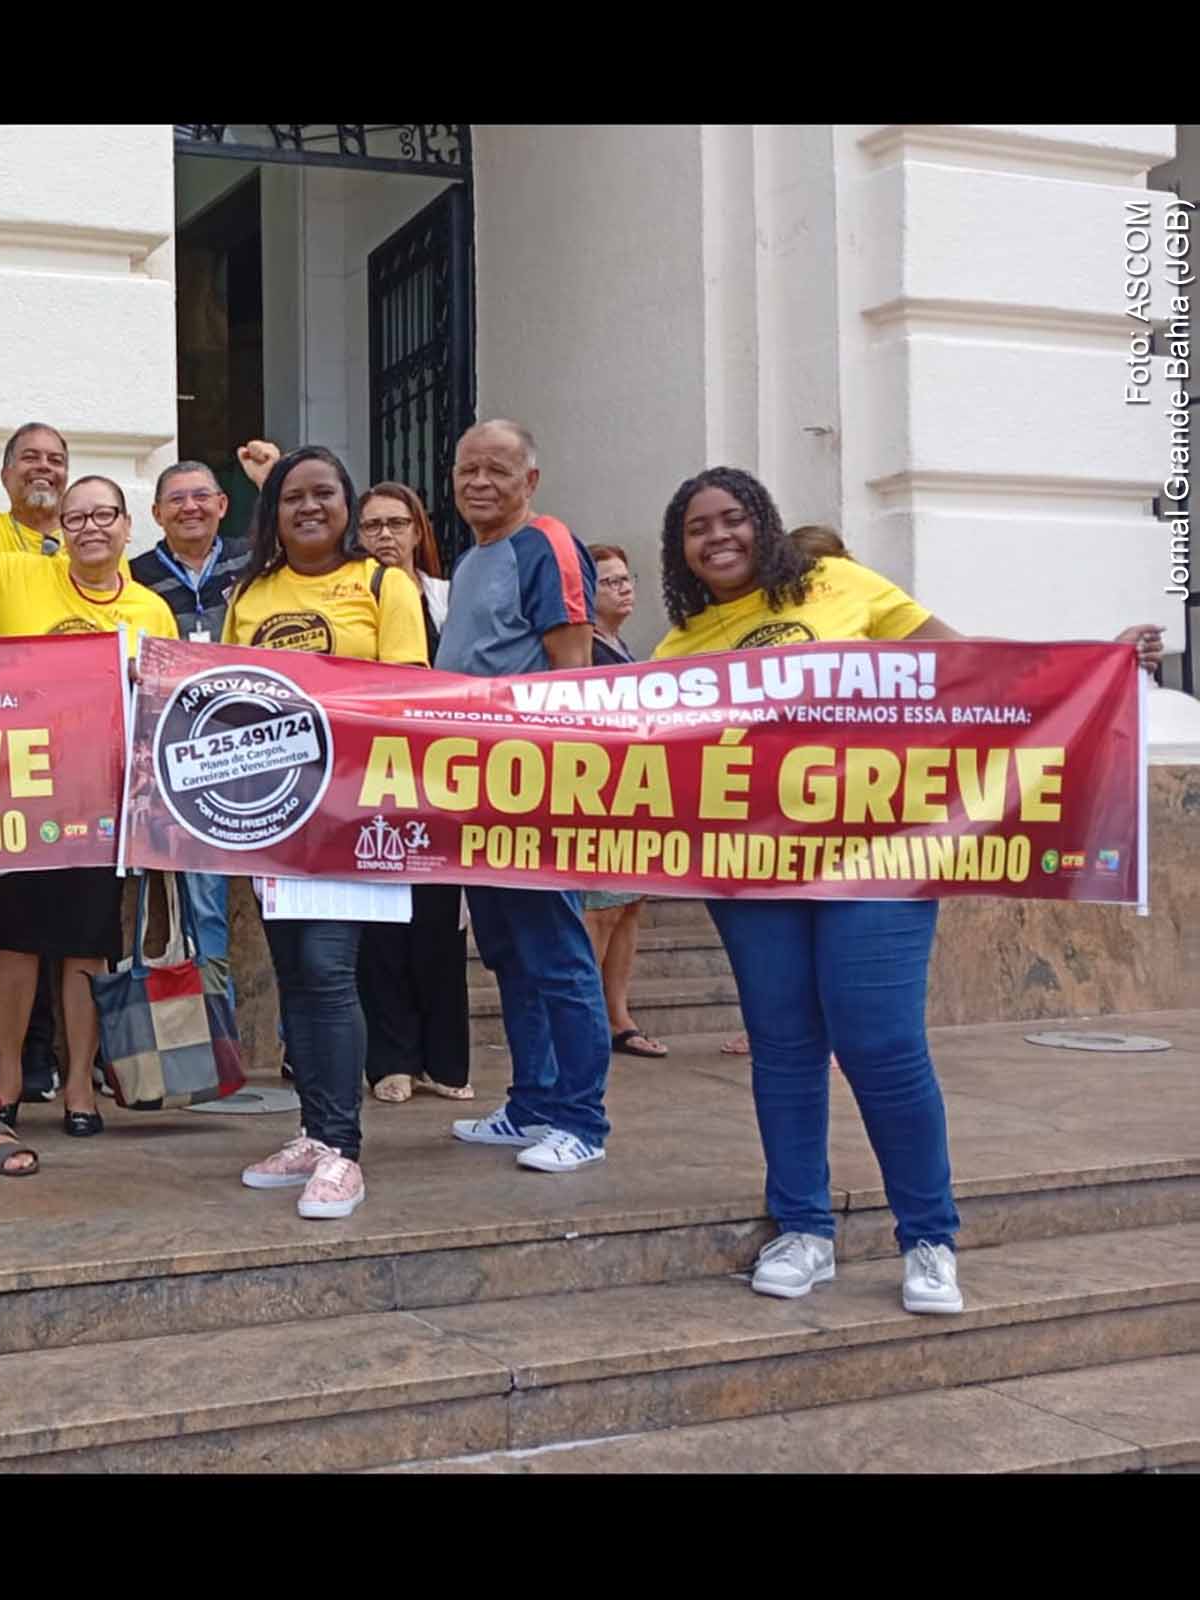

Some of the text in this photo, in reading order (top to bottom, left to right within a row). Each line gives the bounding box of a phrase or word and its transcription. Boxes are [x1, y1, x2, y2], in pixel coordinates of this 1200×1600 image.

[181, 678, 291, 712] APROVAÇÃO
[511, 652, 936, 712] VAMOS LUTAR!
[403, 708, 514, 723] SERVIDORES
[519, 713, 585, 726] VAMOS
[645, 710, 722, 727] FORÇAS
[728, 707, 779, 723] PARA
[784, 705, 898, 724] VENCERMOS
[903, 705, 946, 724] ESSA
[952, 705, 1031, 725] BATALHA:
[174, 716, 311, 763] PL 25.491/24
[182, 750, 309, 787] Carreiras e Vencimentos
[200, 745, 286, 772] Plano de Cargos,
[358, 728, 1065, 823] AGORA É GREVE
[194, 798, 213, 819] POR
[214, 813, 240, 828] MAIS
[461, 825, 540, 870] POR
[552, 827, 689, 877] TEMPO
[702, 832, 1030, 883] INDETERMINADO
